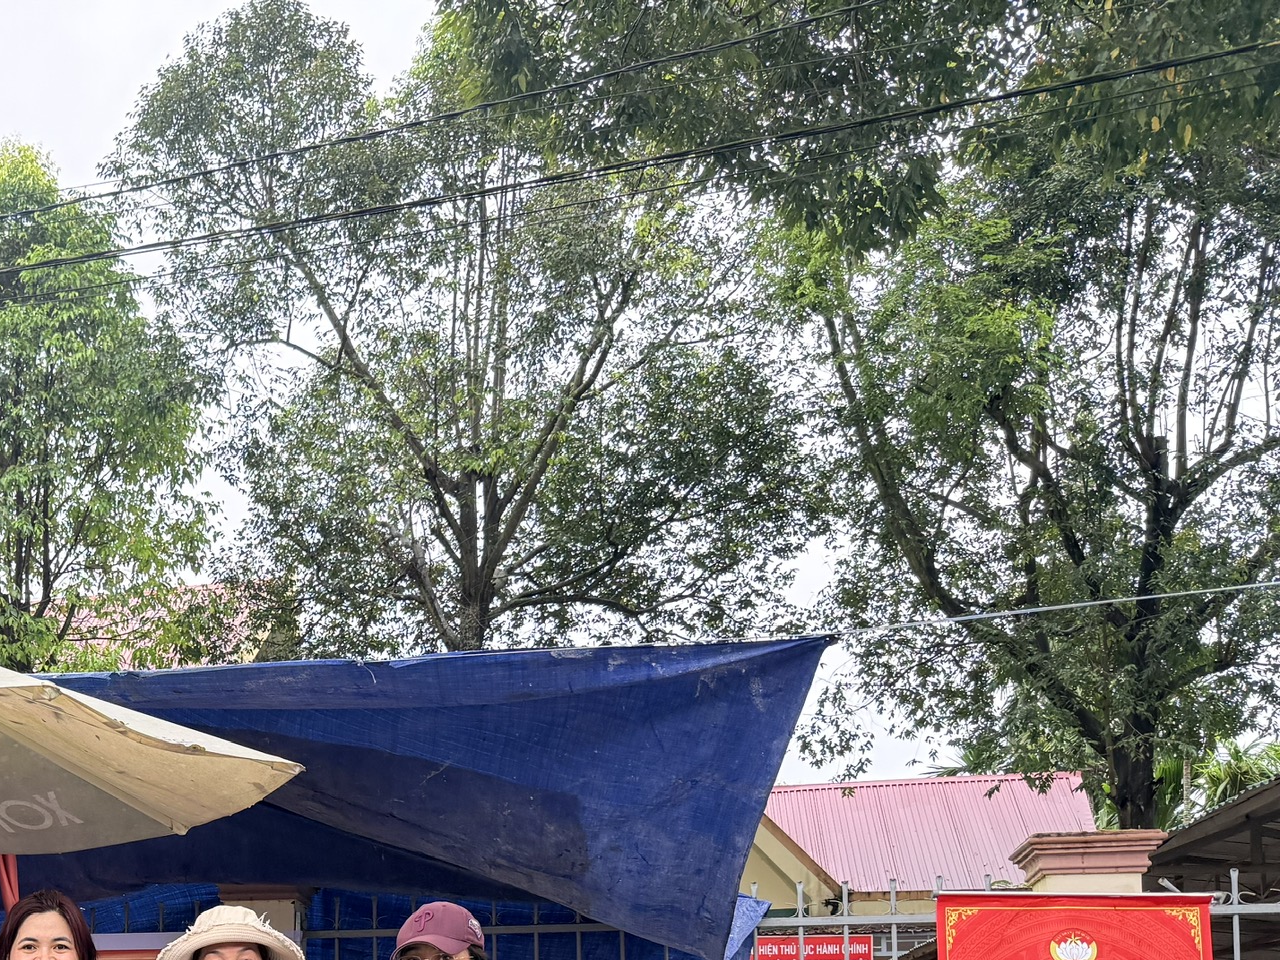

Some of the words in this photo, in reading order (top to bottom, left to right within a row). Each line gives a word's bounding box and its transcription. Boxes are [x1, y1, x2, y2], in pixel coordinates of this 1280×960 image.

[759, 943, 778, 957] HIỆN
[780, 942, 796, 955] THỦ
[798, 944, 814, 957] ỤC
[816, 942, 840, 955] HÀNH
